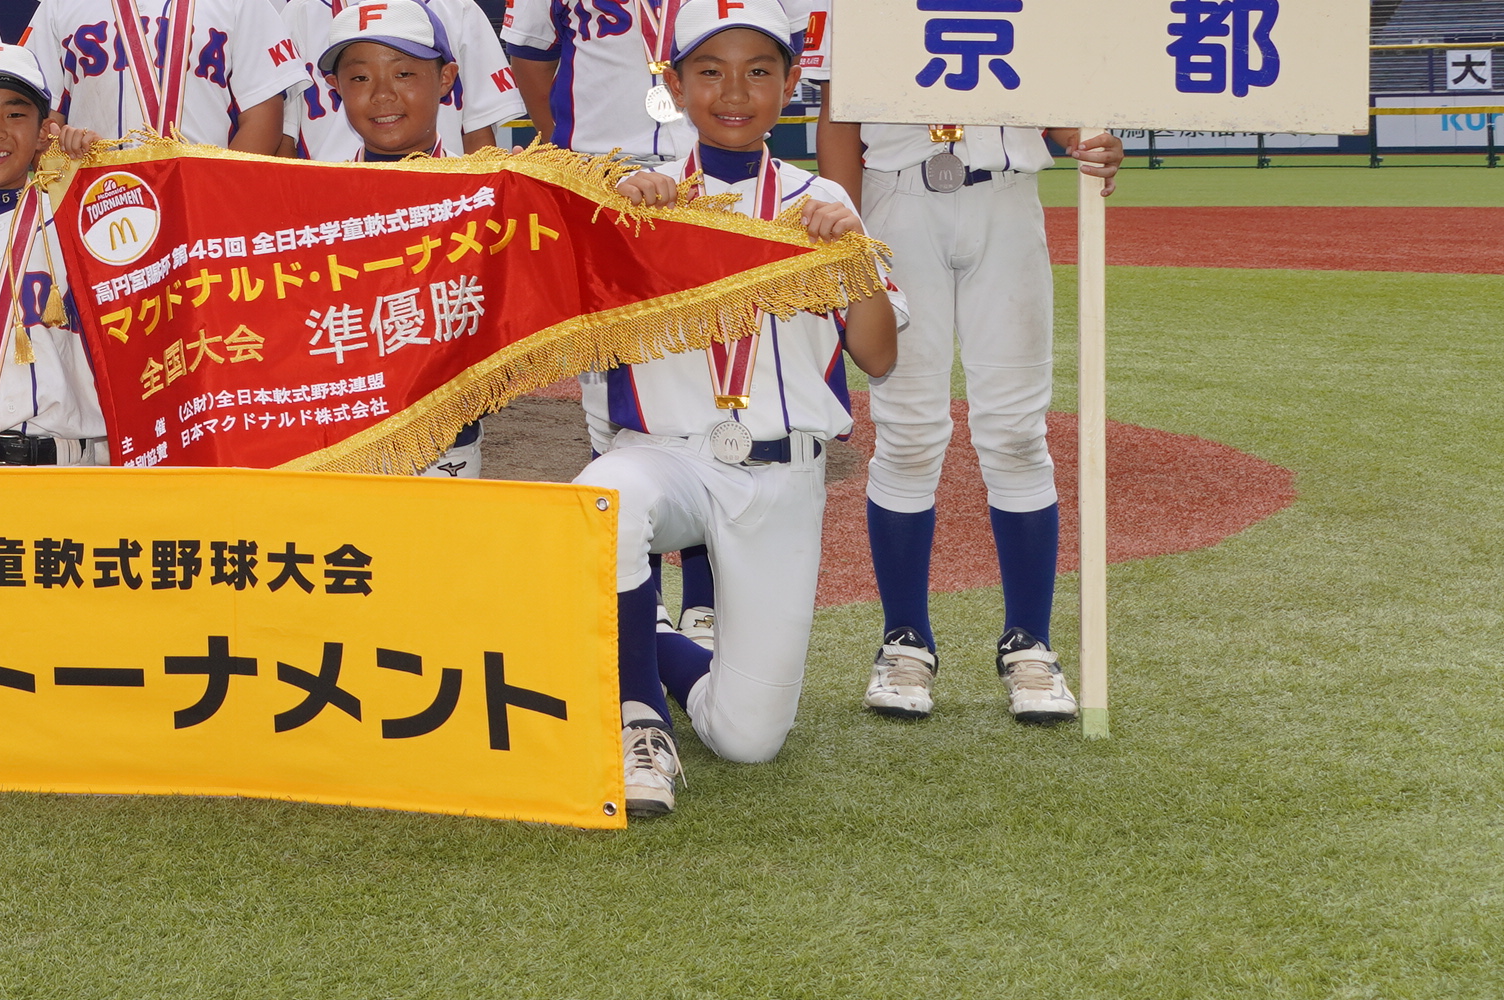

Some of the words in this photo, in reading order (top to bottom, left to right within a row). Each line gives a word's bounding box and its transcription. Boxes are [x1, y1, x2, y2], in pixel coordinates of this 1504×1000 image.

[358, 3, 388, 31] F
[1452, 53, 1487, 85] 大
[86, 187, 145, 224] TOURNAMENT
[91, 253, 171, 305] 高円宮賜杯
[171, 236, 248, 270] 第45回
[251, 185, 496, 256] 全日本学童軟式野球大会
[99, 213, 560, 344] マクドナルド・トーナメント
[138, 324, 266, 401] 全国大会
[304, 274, 486, 364] 準優勝
[180, 396, 390, 449] 日本マクドナルド株式会社
